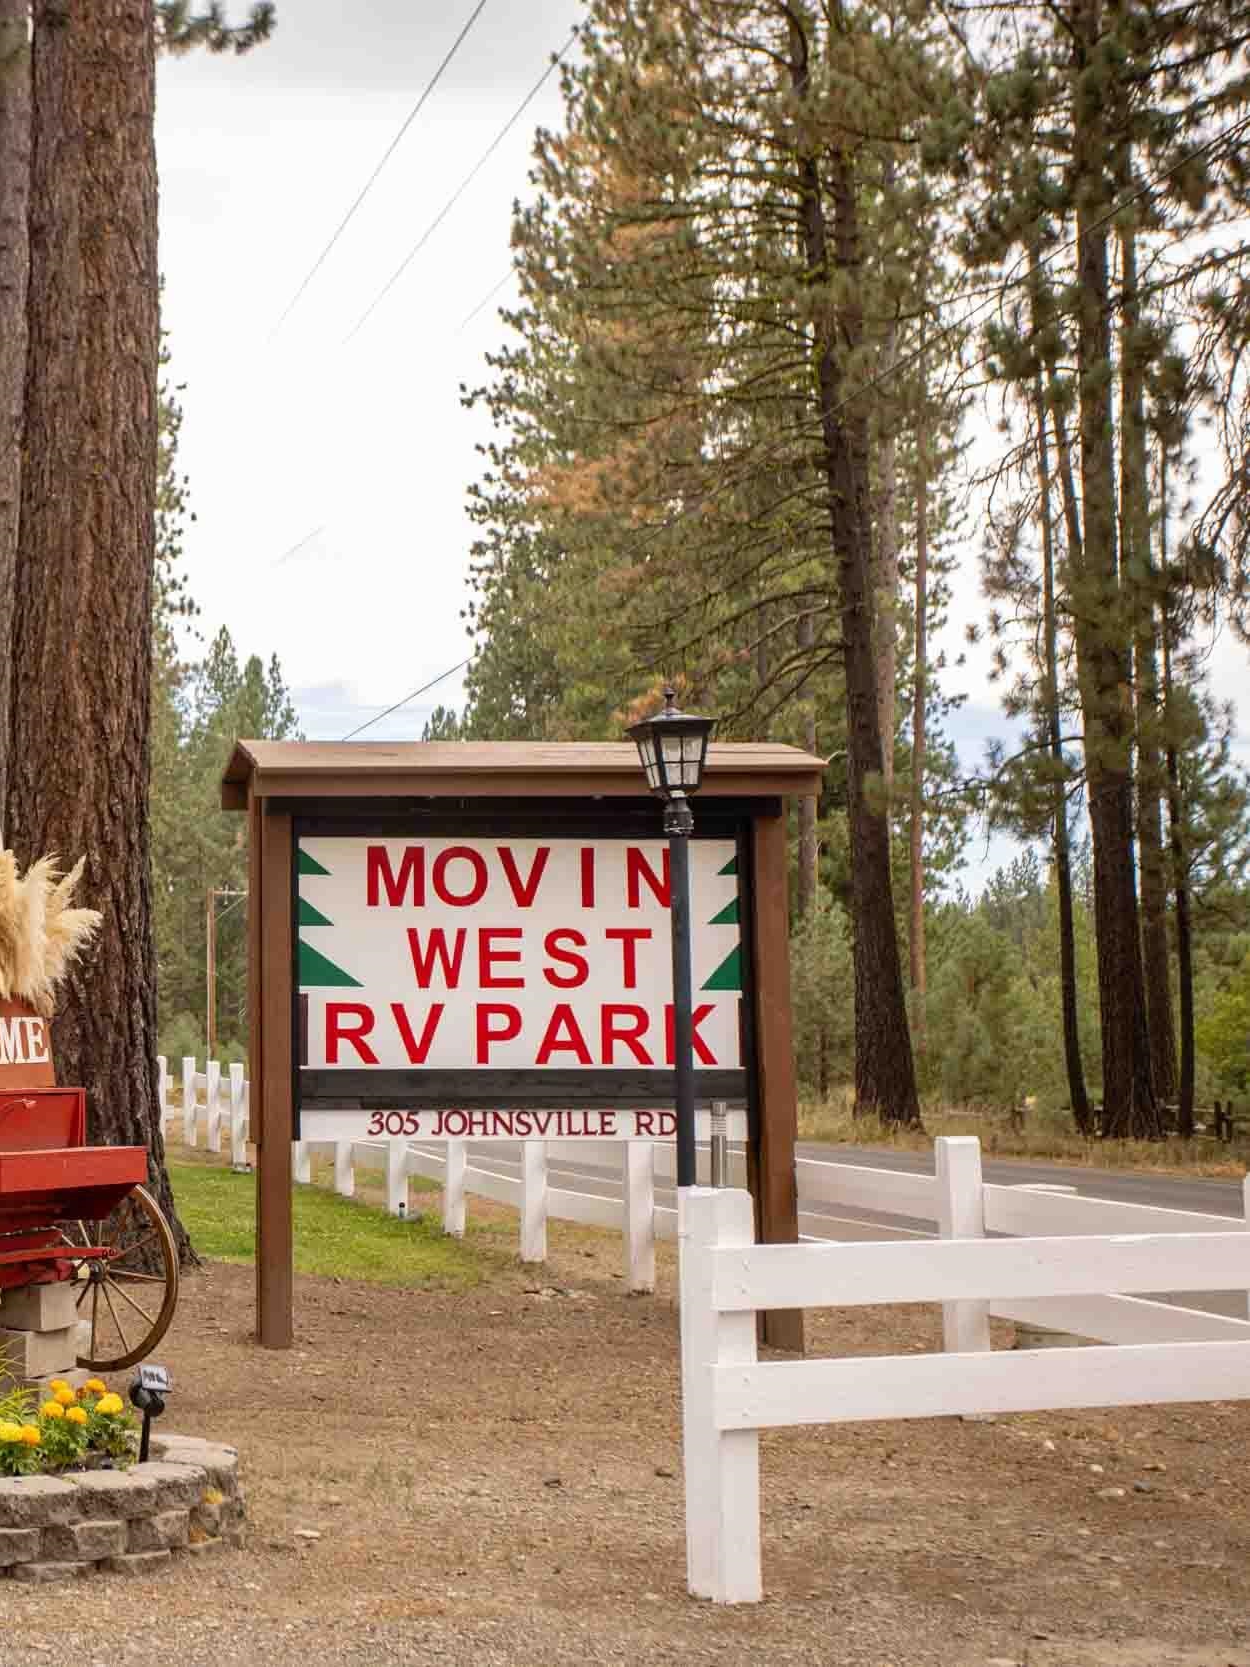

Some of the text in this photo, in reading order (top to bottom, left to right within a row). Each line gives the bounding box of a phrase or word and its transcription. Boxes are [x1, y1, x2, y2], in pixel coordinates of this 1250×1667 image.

[366, 846, 672, 909] MOVIN
[406, 926, 654, 989] WEST
[324, 1002, 719, 1067] RV PARK
[367, 1110, 678, 1137] 305 JOHNSVILLE RD
